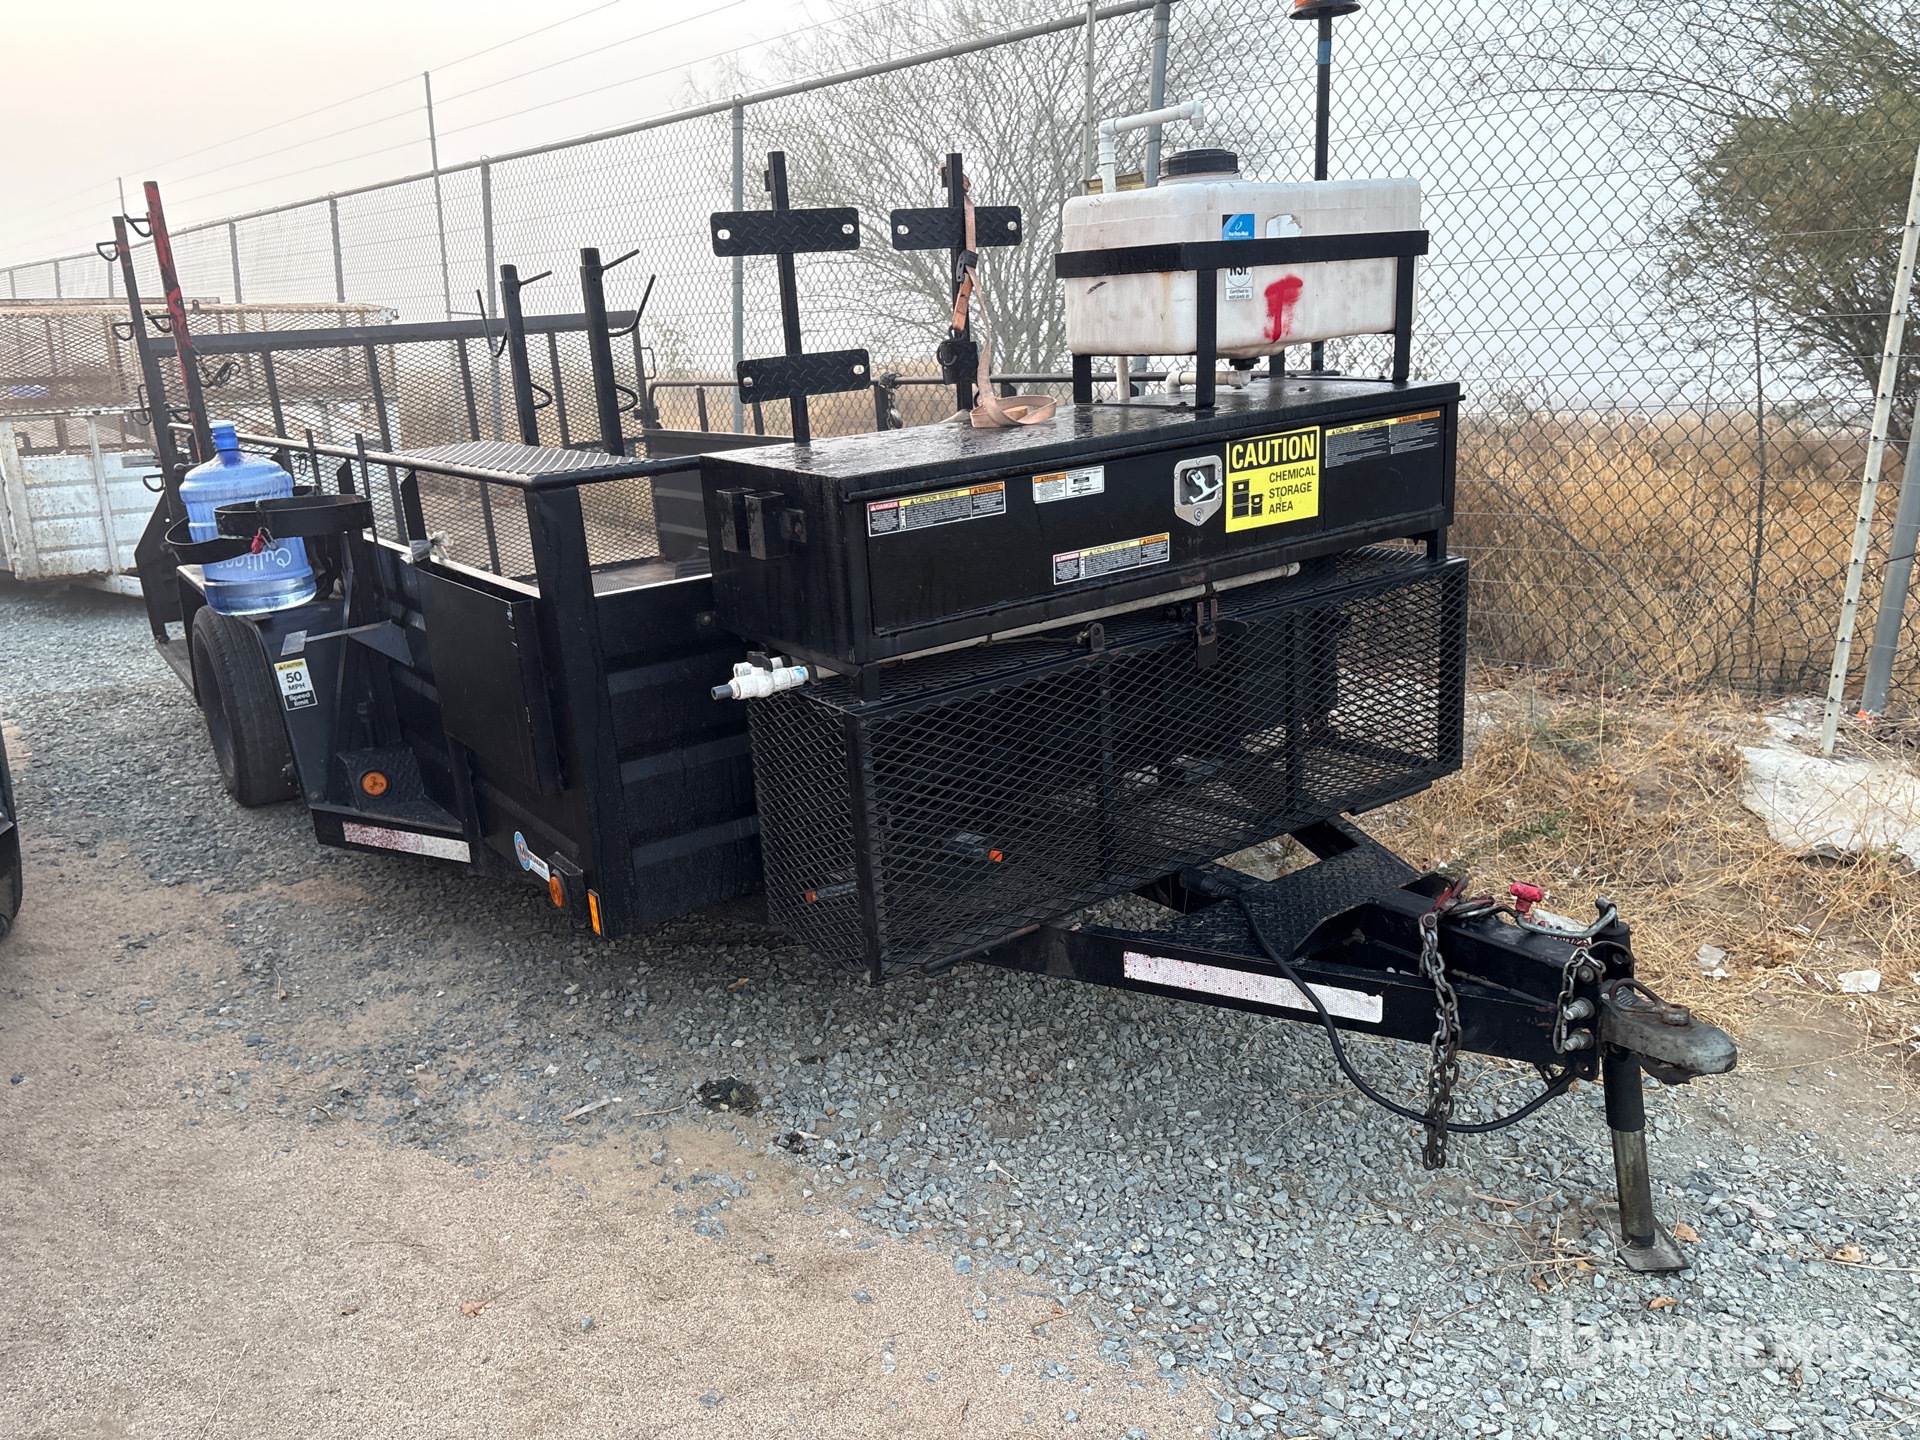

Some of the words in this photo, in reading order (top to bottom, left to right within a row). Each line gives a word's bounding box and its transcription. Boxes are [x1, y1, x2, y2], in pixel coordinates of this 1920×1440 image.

[1231, 433, 1315, 470] CAUTION
[1269, 466, 1316, 483] CHEMICAL
[1268, 481, 1312, 499] STORAGE
[875, 501, 898, 510] DANGER
[1268, 500, 1294, 515] AREA
[283, 661, 304, 669] CAUTION
[285, 671, 303, 684] 50
[288, 682, 306, 692] MPH
[288, 692, 311, 702] Speed
